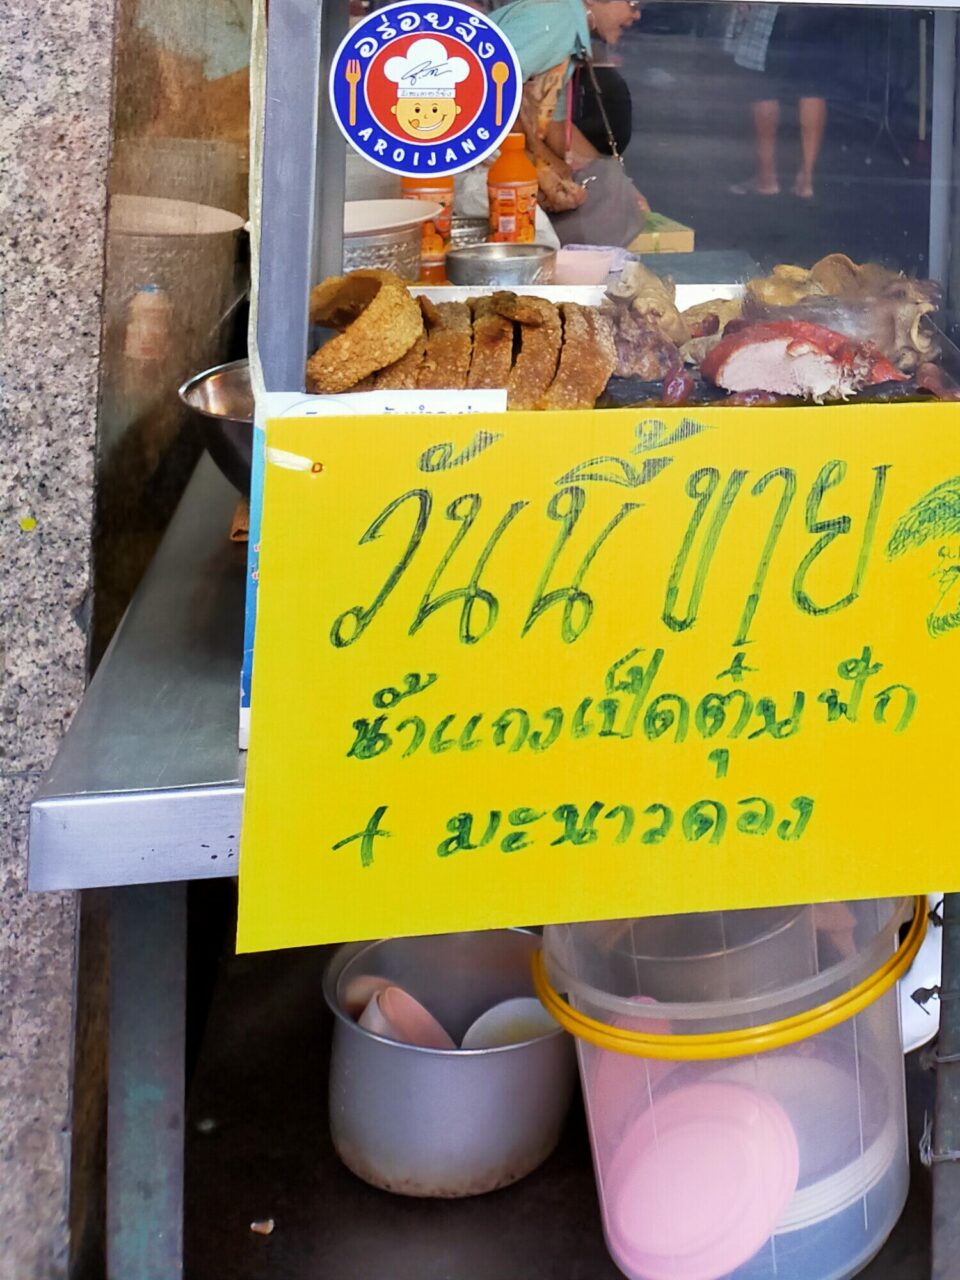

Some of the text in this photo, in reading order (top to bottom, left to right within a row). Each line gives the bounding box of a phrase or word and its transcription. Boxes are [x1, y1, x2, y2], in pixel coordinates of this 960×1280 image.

[354, 11, 496, 59] อร่อยจัง
[358, 127, 490, 166] AROIJANG
